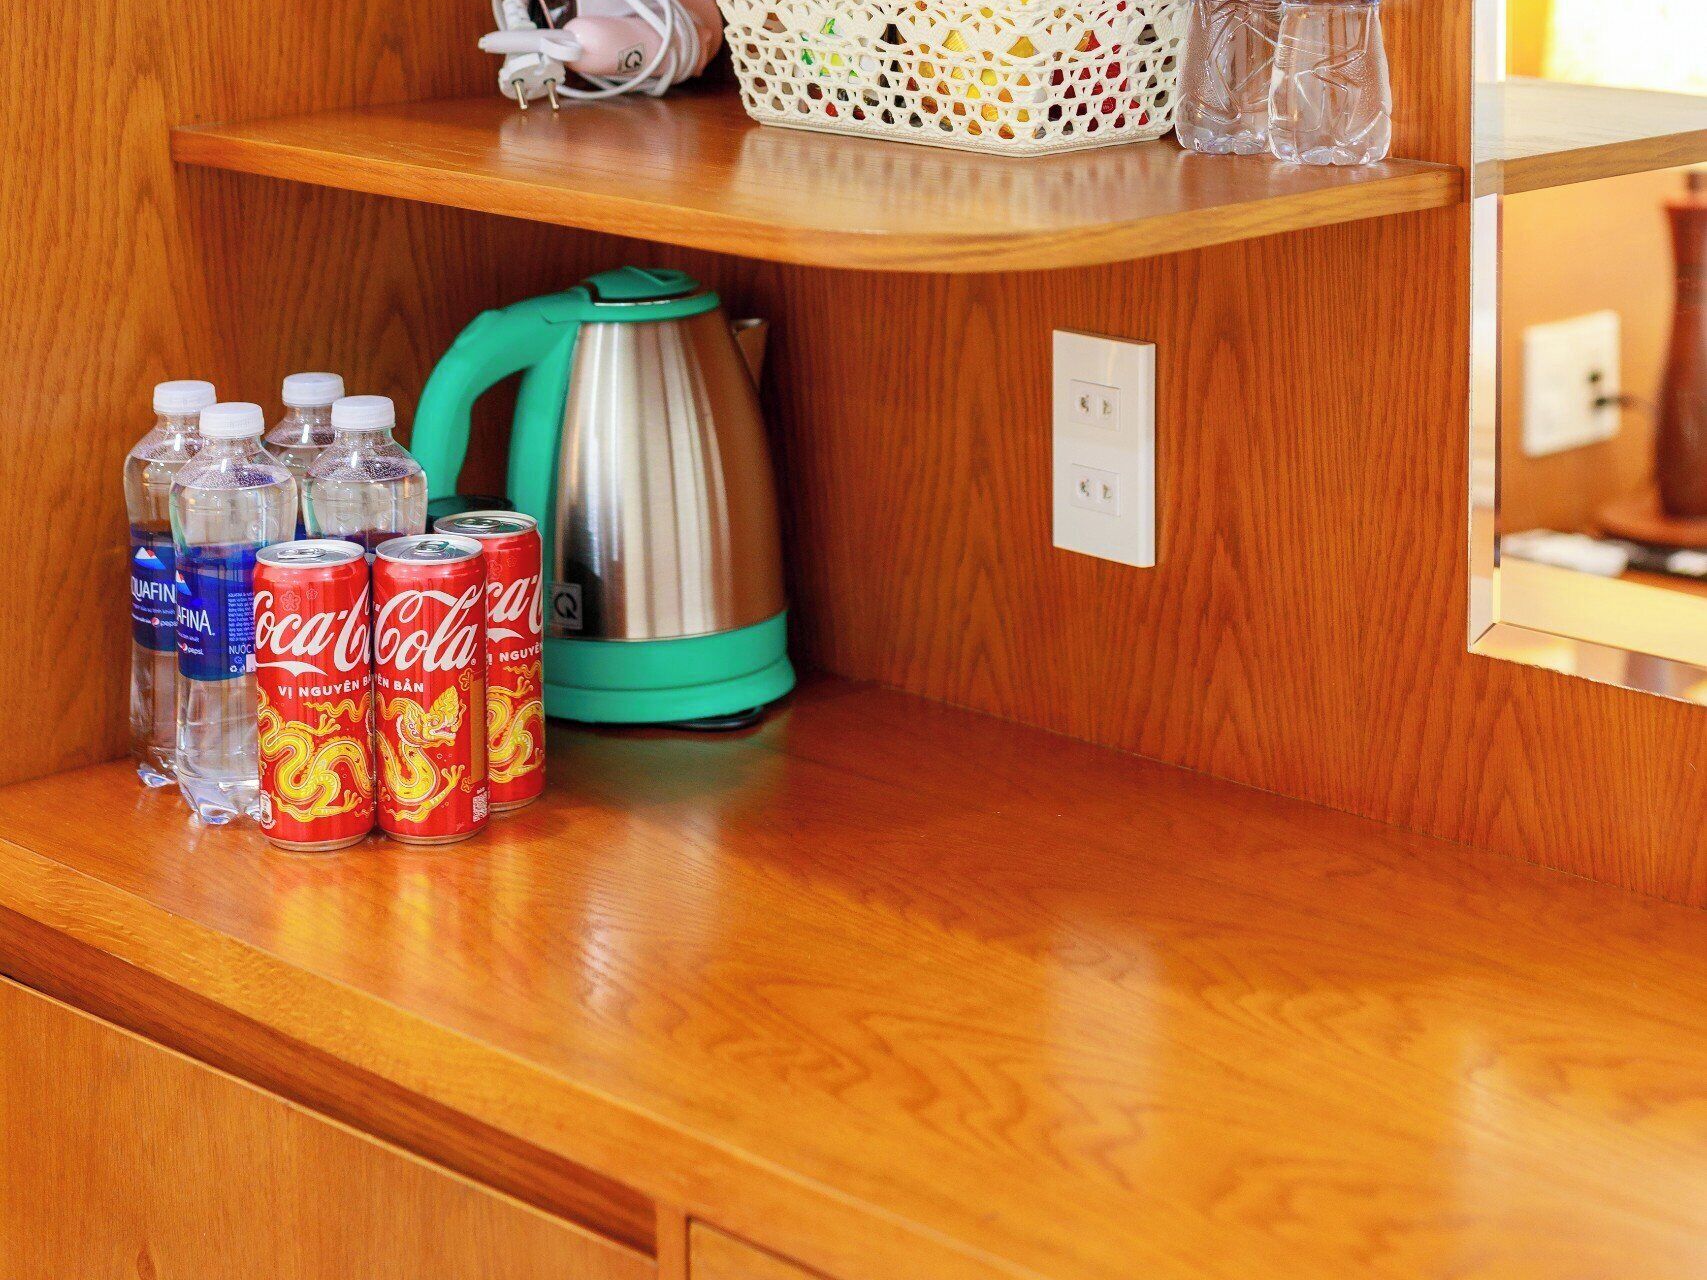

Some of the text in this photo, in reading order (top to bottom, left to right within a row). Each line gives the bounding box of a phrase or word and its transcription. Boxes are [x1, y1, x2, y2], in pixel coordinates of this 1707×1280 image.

[499, 641, 543, 663] NGUYÊ
[299, 679, 360, 697] NGUYÊN
[393, 677, 424, 692] BẢN
